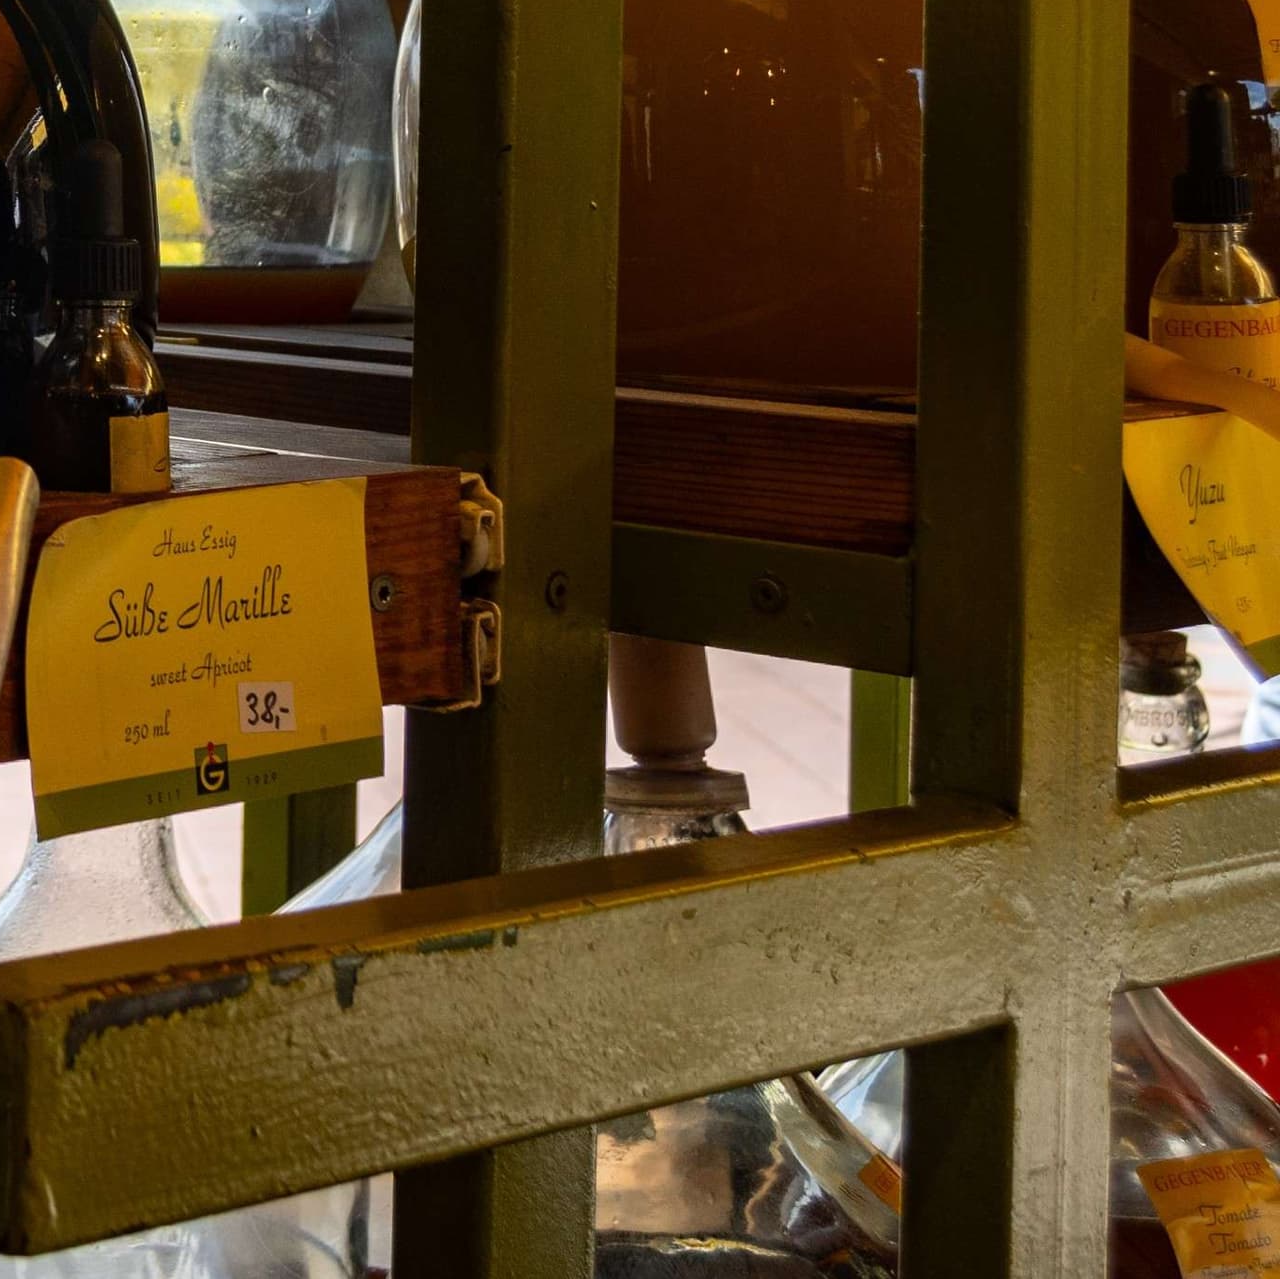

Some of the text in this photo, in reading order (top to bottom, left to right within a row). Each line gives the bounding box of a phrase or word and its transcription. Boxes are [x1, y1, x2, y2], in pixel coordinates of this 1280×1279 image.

[1179, 462, 1226, 526] Yuzu
[152, 524, 238, 560] Haus Essig
[93, 564, 294, 643] Süße Marille
[149, 651, 254, 689] sweet Apricot
[124, 708, 171, 746] 250 ml
[245, 689, 290, 730] 38,-
[145, 787, 182, 807] SEIT
[1153, 1160, 1266, 1193] GEGENBAUER
[1196, 1202, 1262, 1227] Tomate
[1207, 1232, 1273, 1256] Tomato
